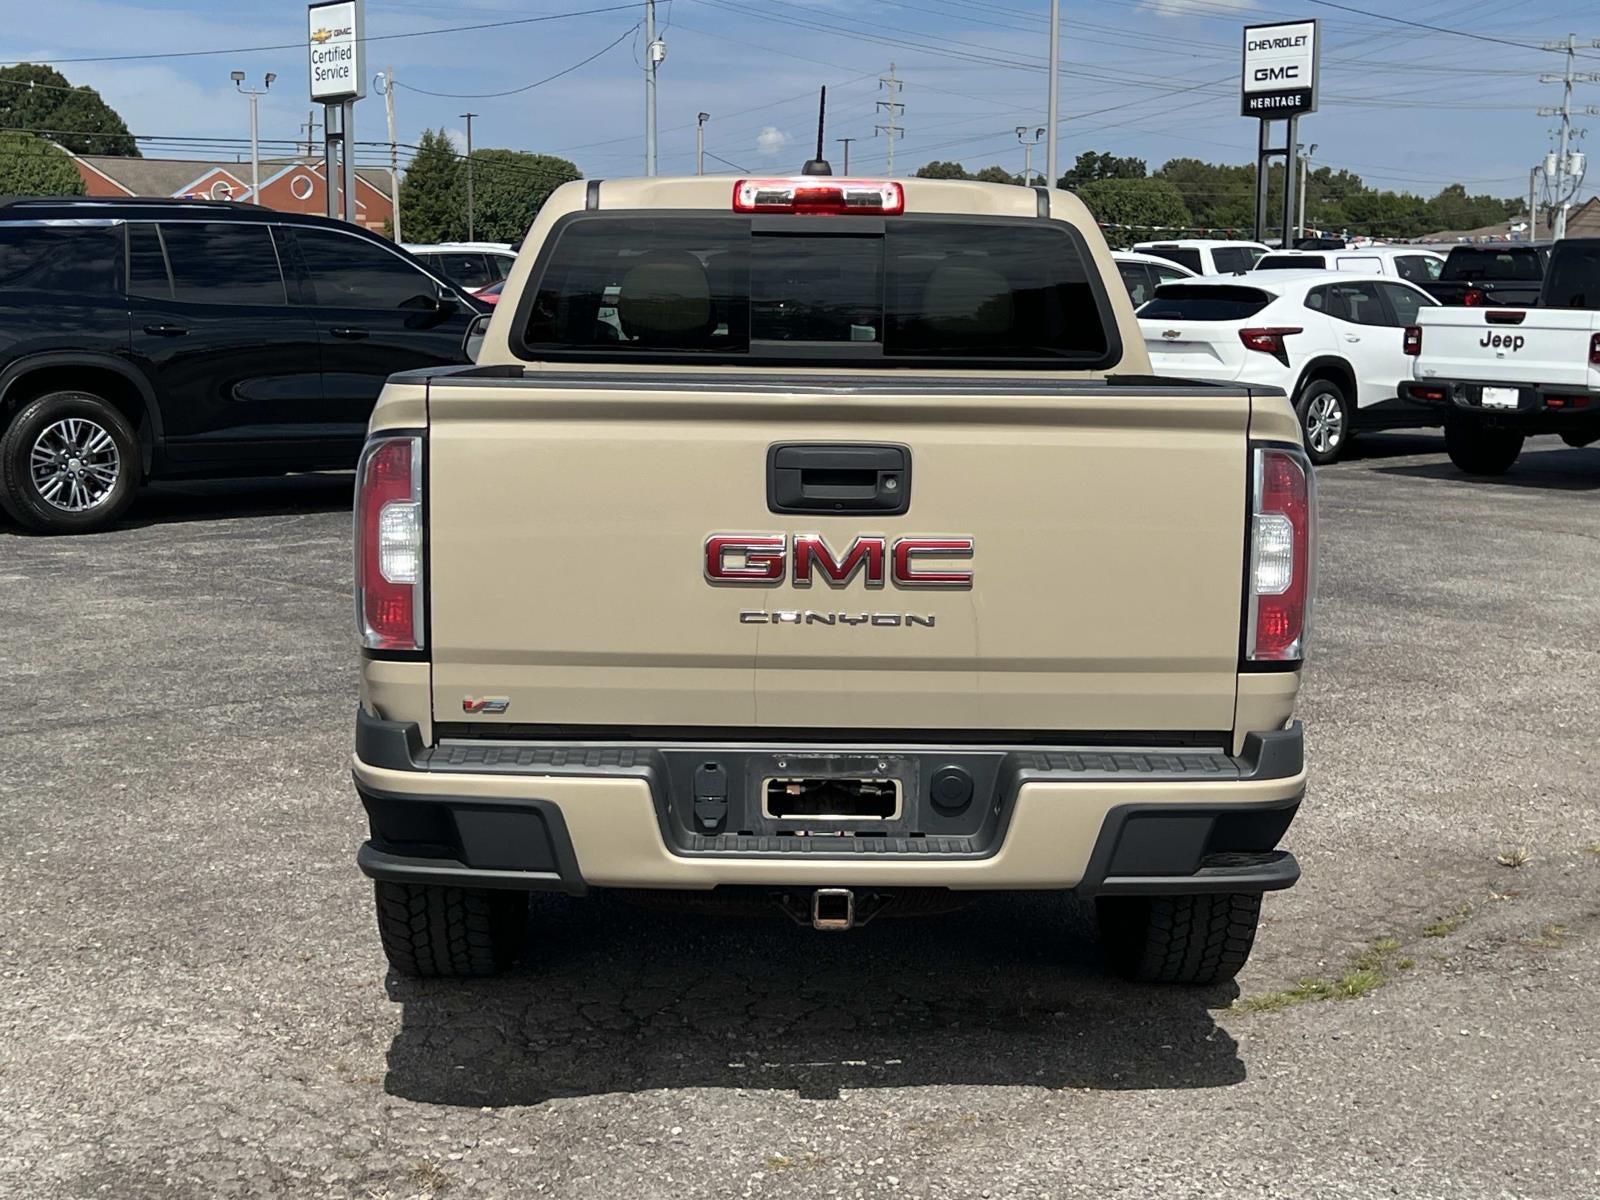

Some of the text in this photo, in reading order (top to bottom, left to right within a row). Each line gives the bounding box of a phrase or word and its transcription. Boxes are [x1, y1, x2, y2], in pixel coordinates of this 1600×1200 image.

[333, 27, 352, 36] GMC
[1248, 35, 1307, 51] CHEVROLET
[312, 46, 352, 64] Certified
[315, 64, 349, 81] Service
[1254, 65, 1299, 81] GMC
[1250, 95, 1302, 109] HERITAGE
[1480, 330, 1525, 352] Jeep
[704, 532, 974, 591] GMC
[739, 609, 936, 627] CANYON
